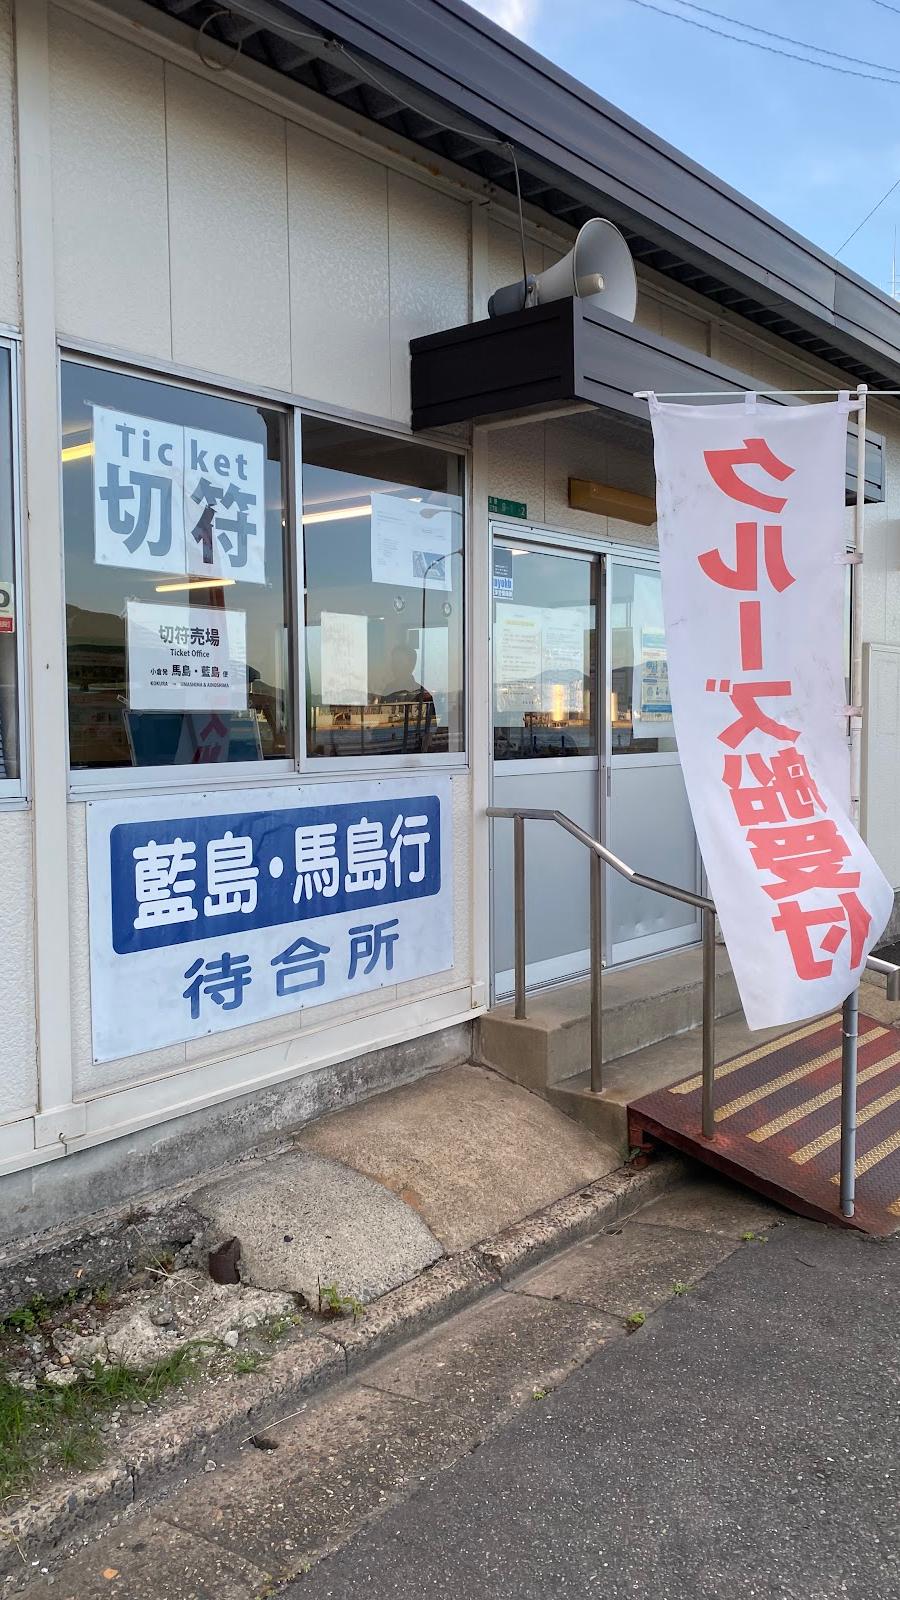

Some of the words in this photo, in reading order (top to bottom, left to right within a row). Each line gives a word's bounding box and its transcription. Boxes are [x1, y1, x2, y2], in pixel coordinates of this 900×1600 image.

[115, 423, 249, 481] Ticket
[98, 462, 257, 568] 切符
[158, 624, 220, 647] 切符売場
[170, 648, 190, 658] Ticket
[191, 649, 210, 659] Office
[150, 668, 168, 676] 小倉発
[171, 664, 220, 678] 馬島・藍島
[132, 814, 431, 930] 藍島・馬島行
[182, 918, 400, 1020] 待合所
